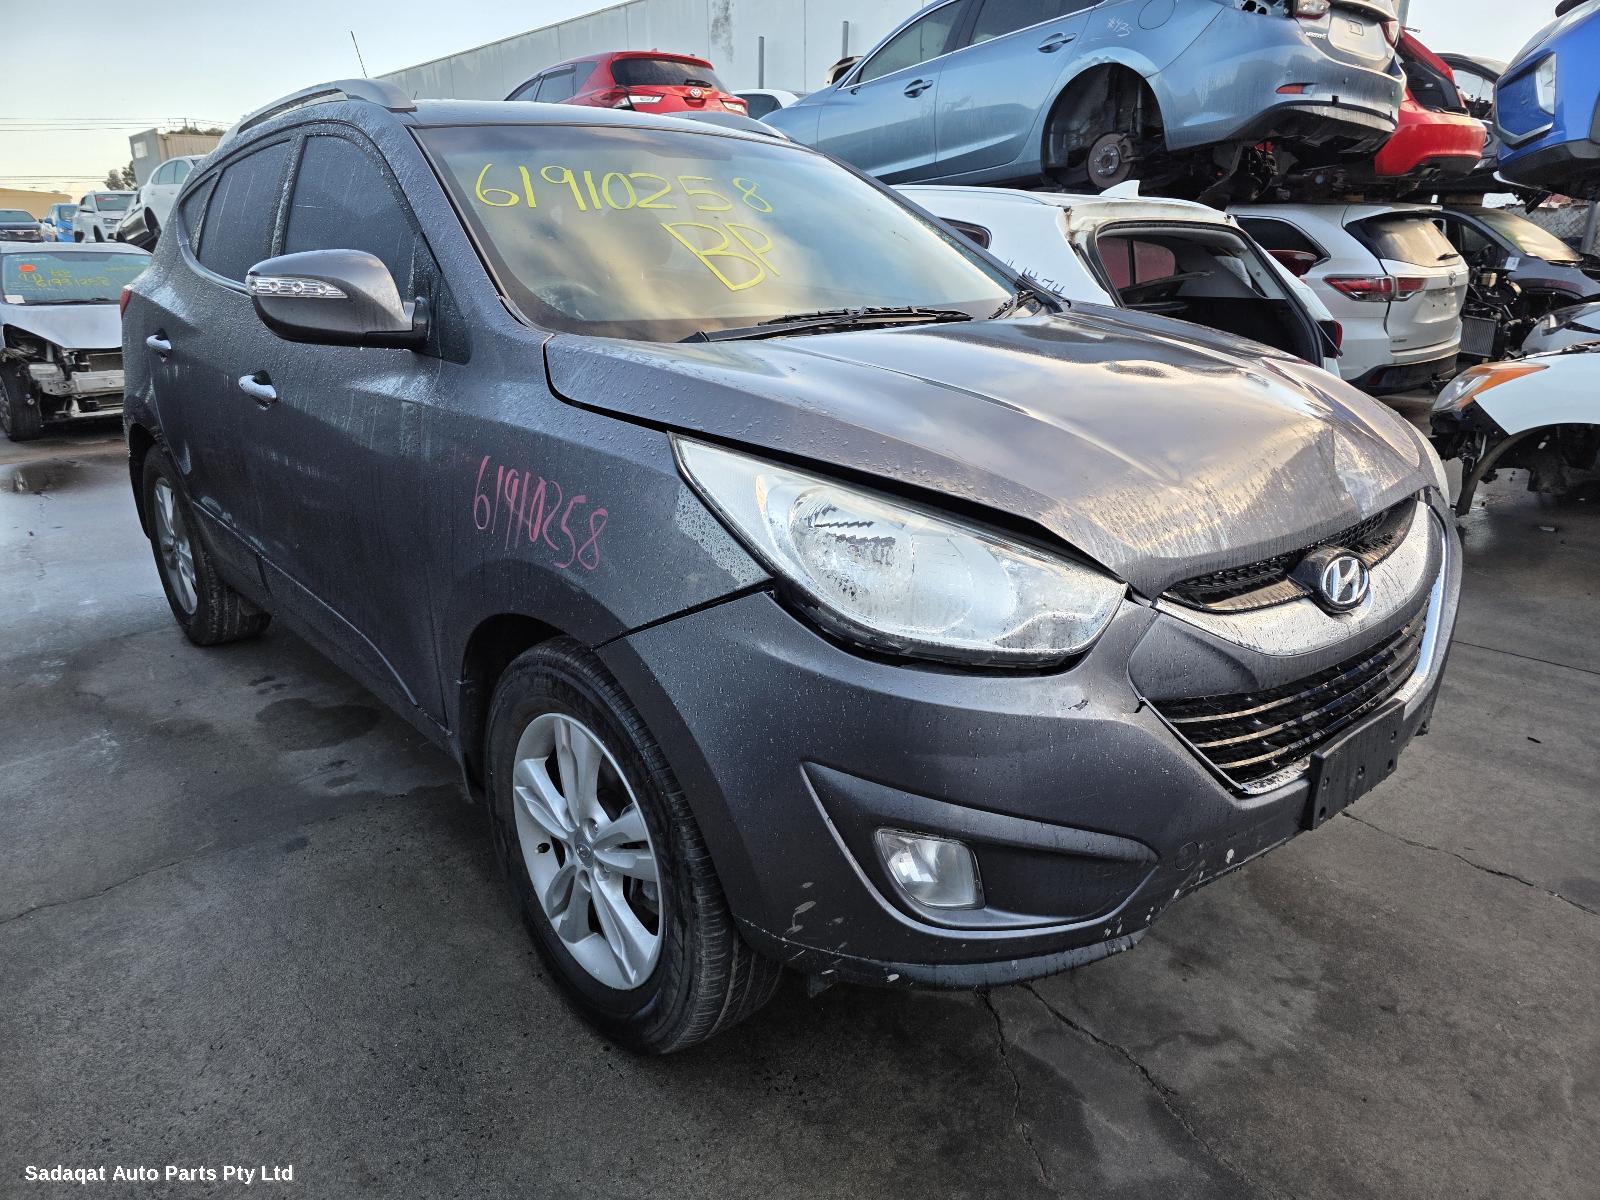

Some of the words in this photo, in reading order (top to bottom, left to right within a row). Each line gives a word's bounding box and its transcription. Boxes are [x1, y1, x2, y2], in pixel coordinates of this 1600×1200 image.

[475, 163, 773, 213] 61910258
[659, 222, 782, 292] BP
[473, 455, 609, 570] 61910258
